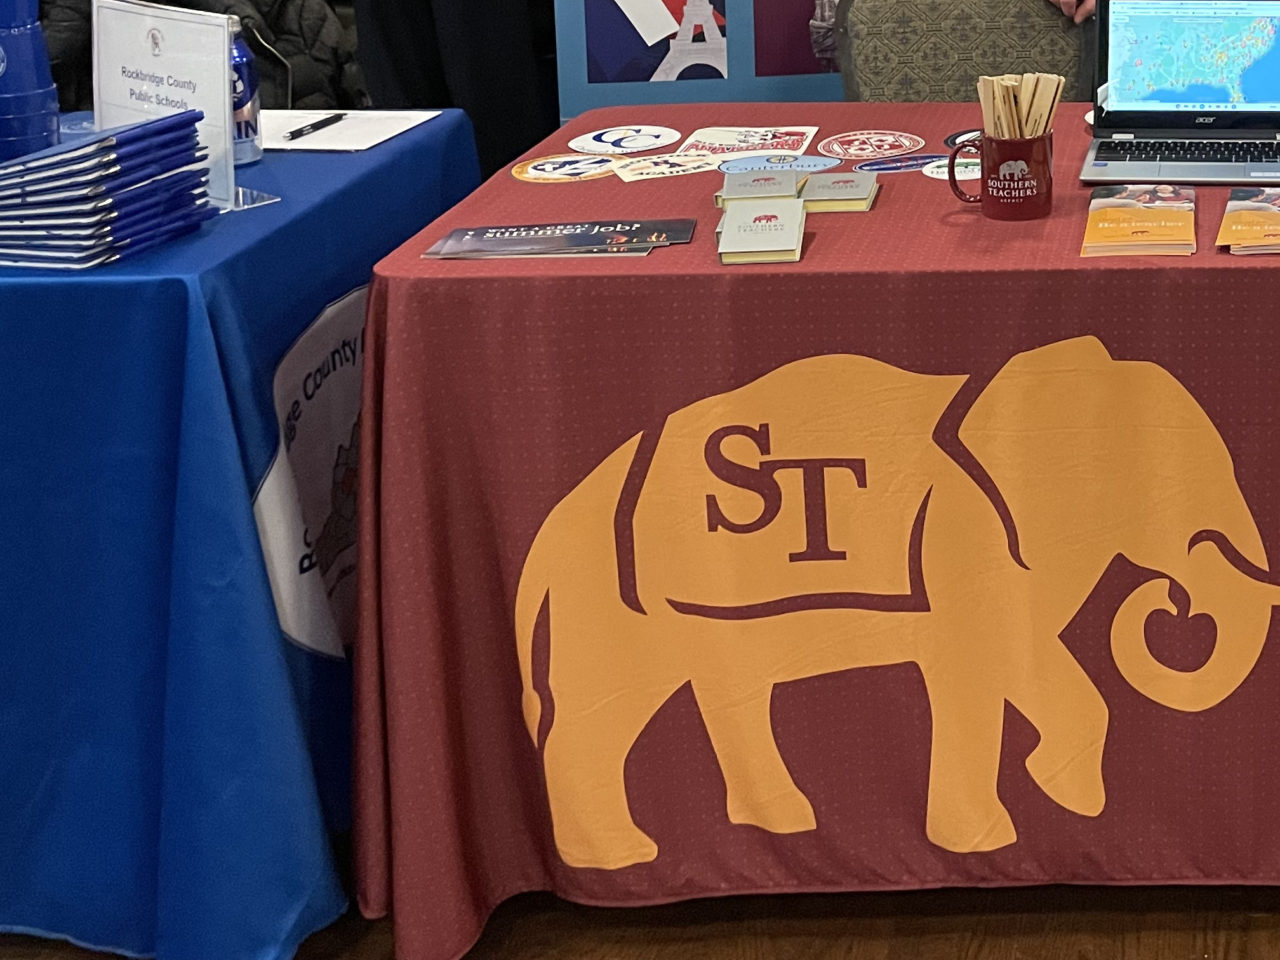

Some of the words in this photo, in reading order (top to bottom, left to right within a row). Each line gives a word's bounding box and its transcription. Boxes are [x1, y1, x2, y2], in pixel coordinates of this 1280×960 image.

[121, 66, 165, 87] Rockbridge
[166, 76, 197, 93] County
[129, 88, 153, 105] Public
[155, 94, 188, 110] Schools
[988, 179, 1037, 189] SOUTHERN
[988, 187, 1037, 197] TEACHERS
[302, 337, 358, 402] County
[703, 423, 867, 563] ST
